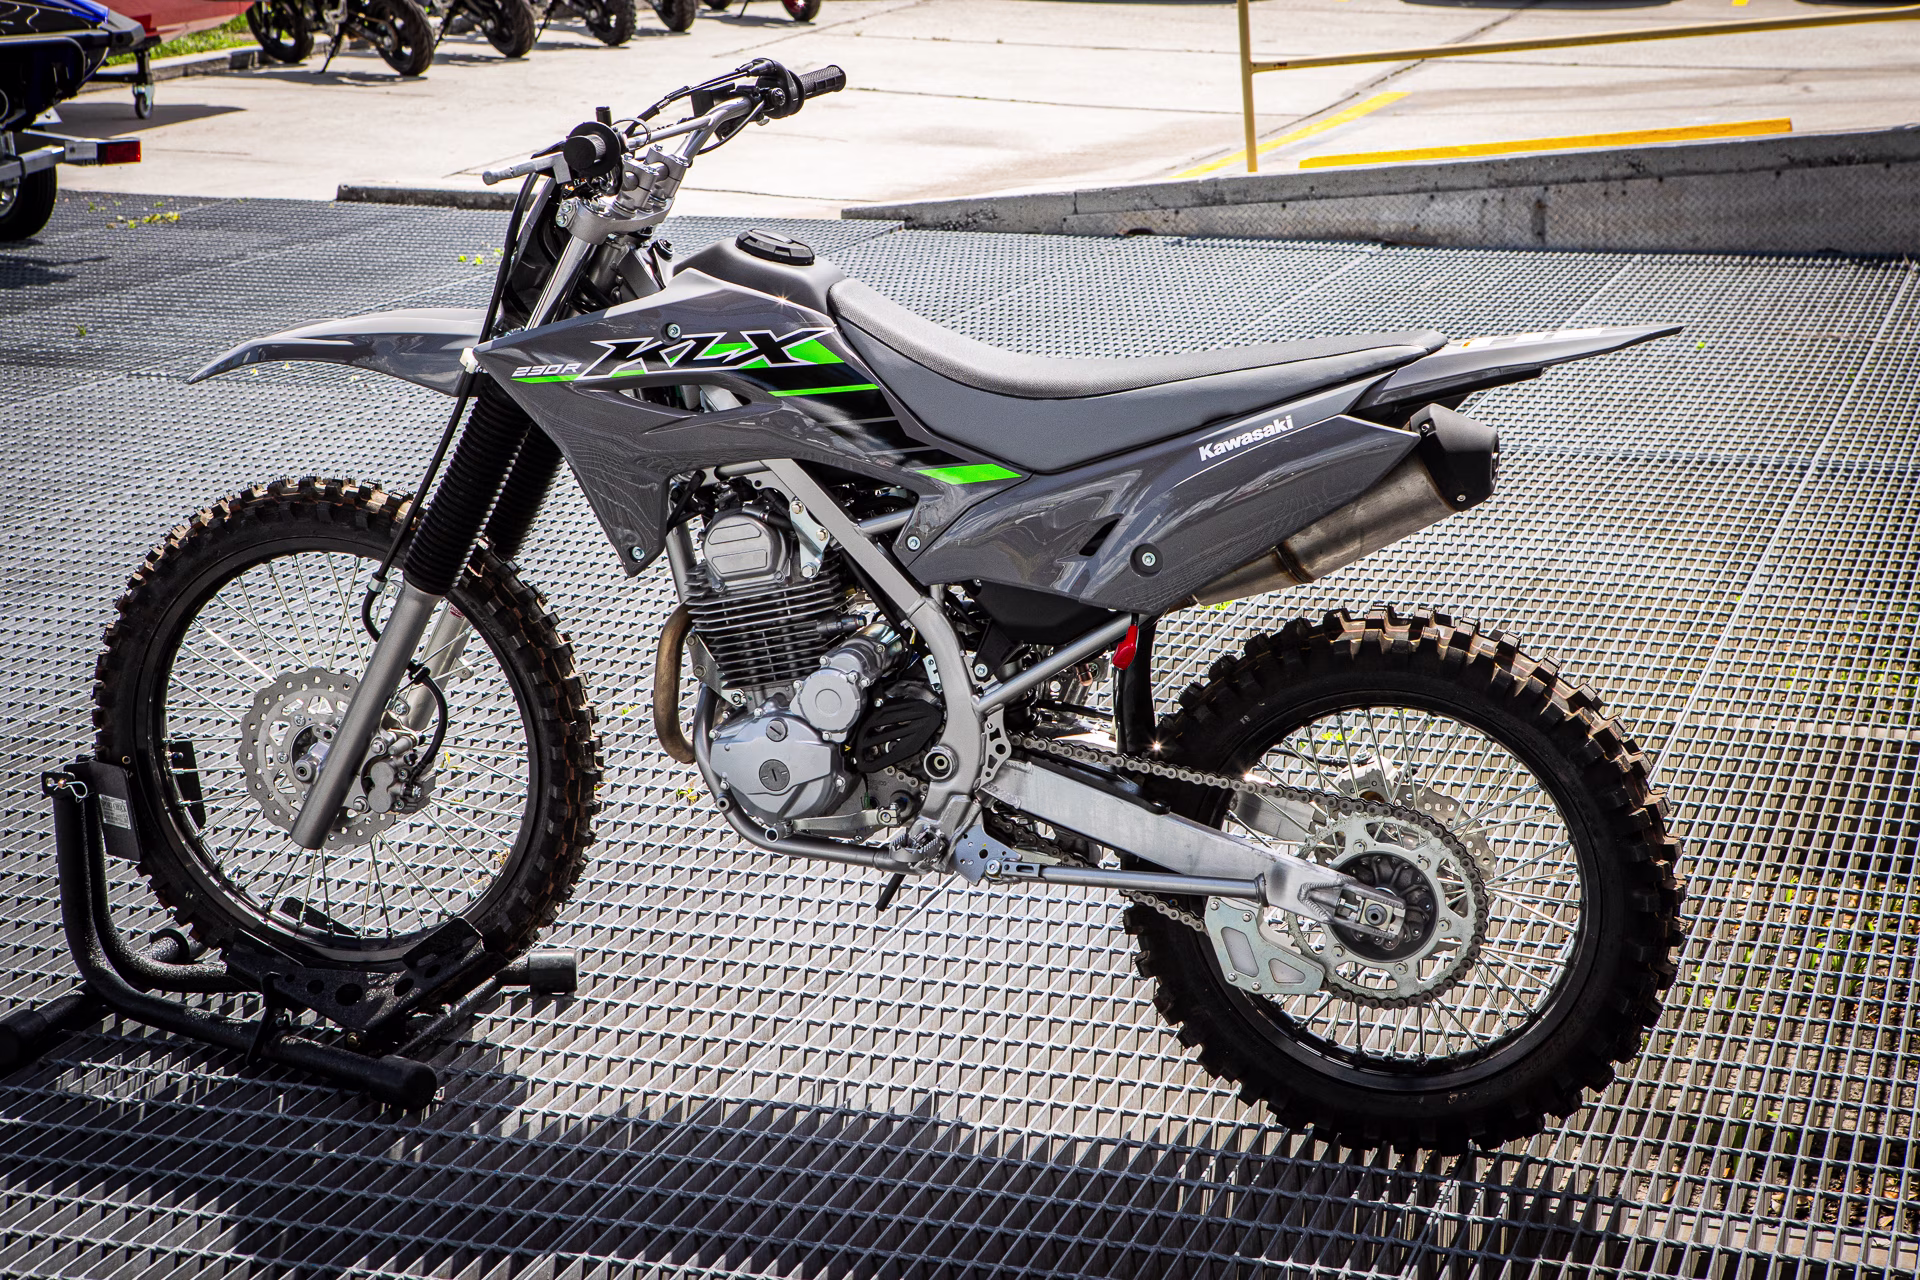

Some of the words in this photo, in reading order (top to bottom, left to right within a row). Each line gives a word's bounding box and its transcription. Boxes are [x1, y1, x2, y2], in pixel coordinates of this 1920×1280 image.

[511, 362, 582, 378] 230R
[574, 327, 836, 380] KLX
[1198, 414, 1294, 462] Kawasaki
